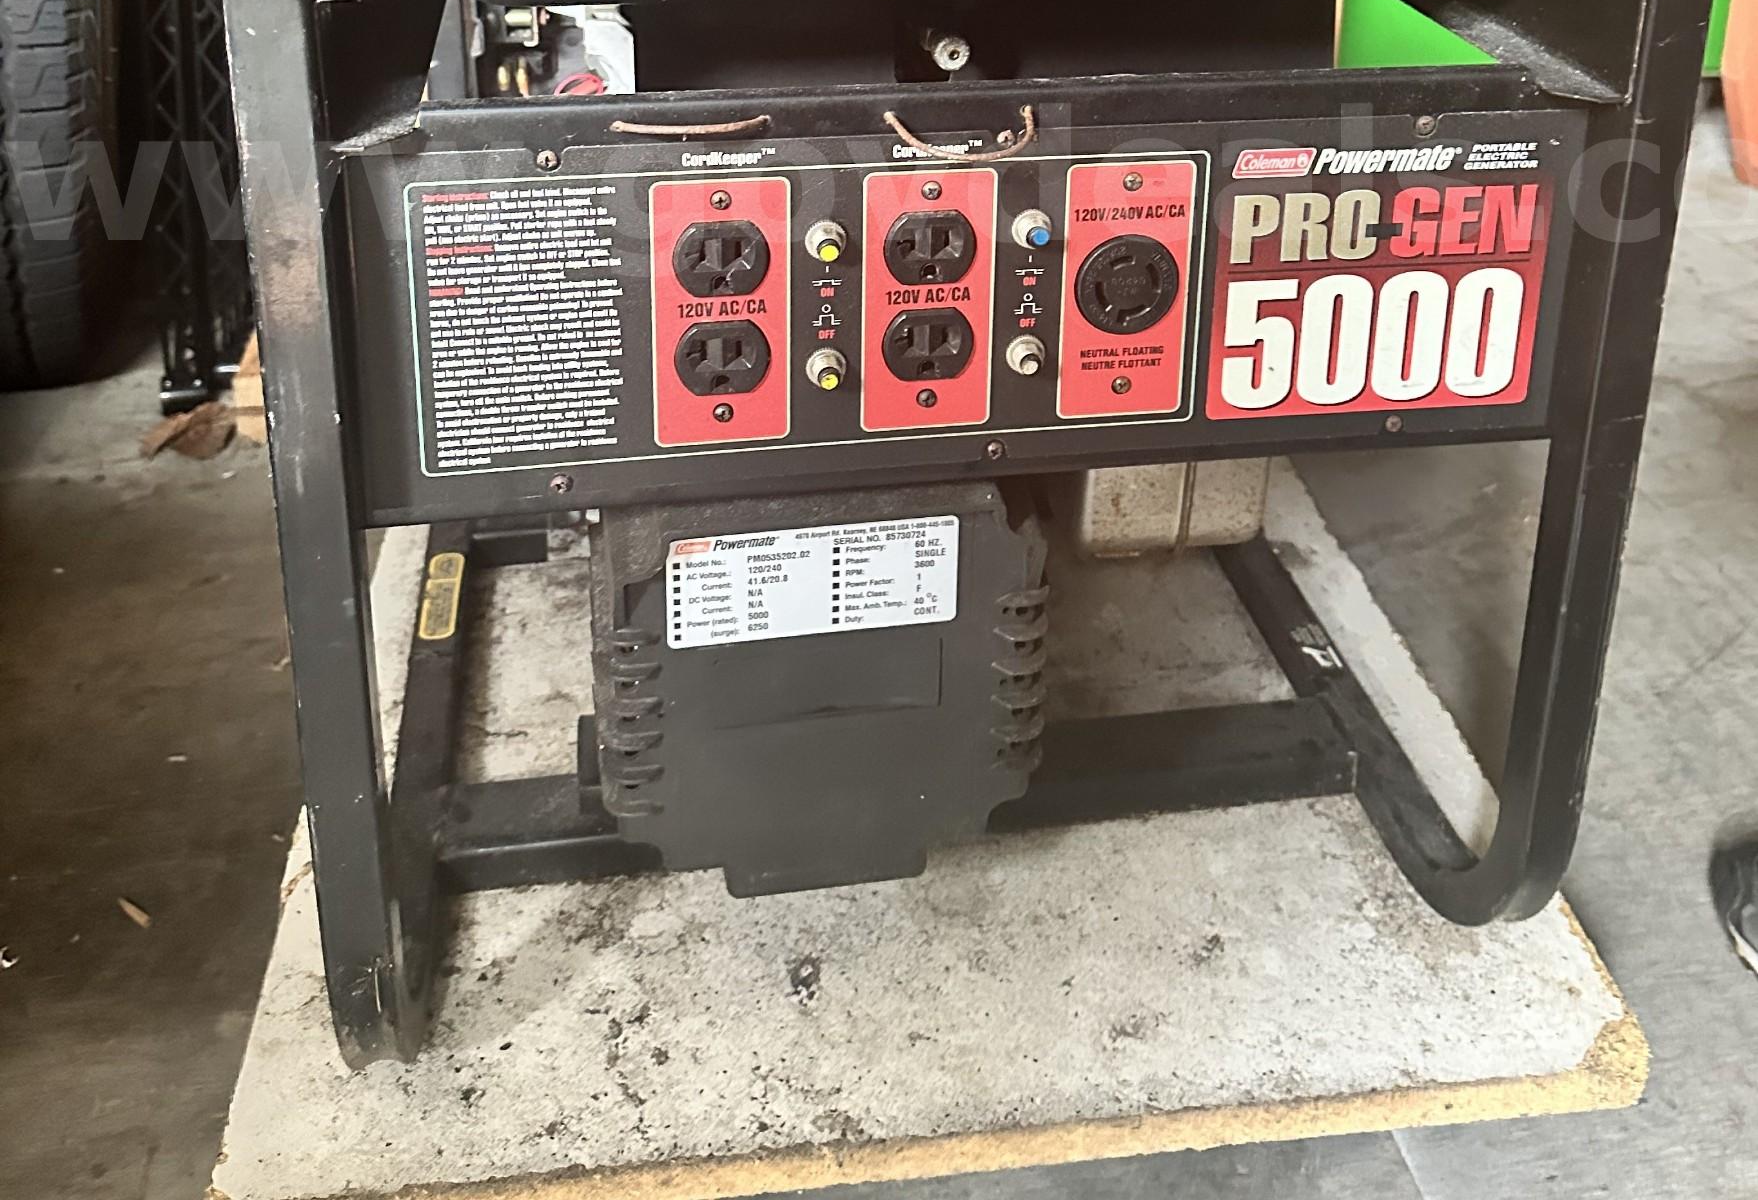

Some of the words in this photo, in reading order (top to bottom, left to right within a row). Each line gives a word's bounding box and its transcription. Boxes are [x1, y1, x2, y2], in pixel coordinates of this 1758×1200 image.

[1472, 142, 1538, 152] PORTABLE
[1240, 153, 1297, 170] Coleman
[1468, 152, 1528, 161] ELECTRIC
[1463, 160, 1539, 170] GENERATOR
[1075, 207, 1143, 221] 120V/240V
[1145, 205, 1185, 218] AC/CA
[1023, 276, 1036, 286] ON
[820, 287, 835, 297] ON
[886, 290, 920, 305] 120V
[925, 287, 970, 302] AC/CA
[678, 303, 713, 318] 120V
[719, 299, 767, 315] AC/CA
[1019, 318, 1036, 327] OFF
[818, 330, 835, 339] OFF
[1221, 267, 1524, 411] 5000
[1080, 348, 1119, 358] NEUTRAL
[1122, 346, 1164, 355] FLOATING
[1081, 360, 1116, 370] NEUTRE
[1118, 358, 1161, 369] FLOTTANT
[834, 536, 864, 545] SERIAL
[886, 531, 926, 540] 85730724
[915, 548, 946, 557] SINGLE
[748, 564, 782, 573] 120/240
[914, 560, 935, 568] 3600
[748, 575, 788, 585] 41.6/20.8
[748, 589, 763, 597] N/A
[748, 600, 763, 608] N/A
[748, 611, 769, 620] 5000
[748, 622, 768, 631] 6250
